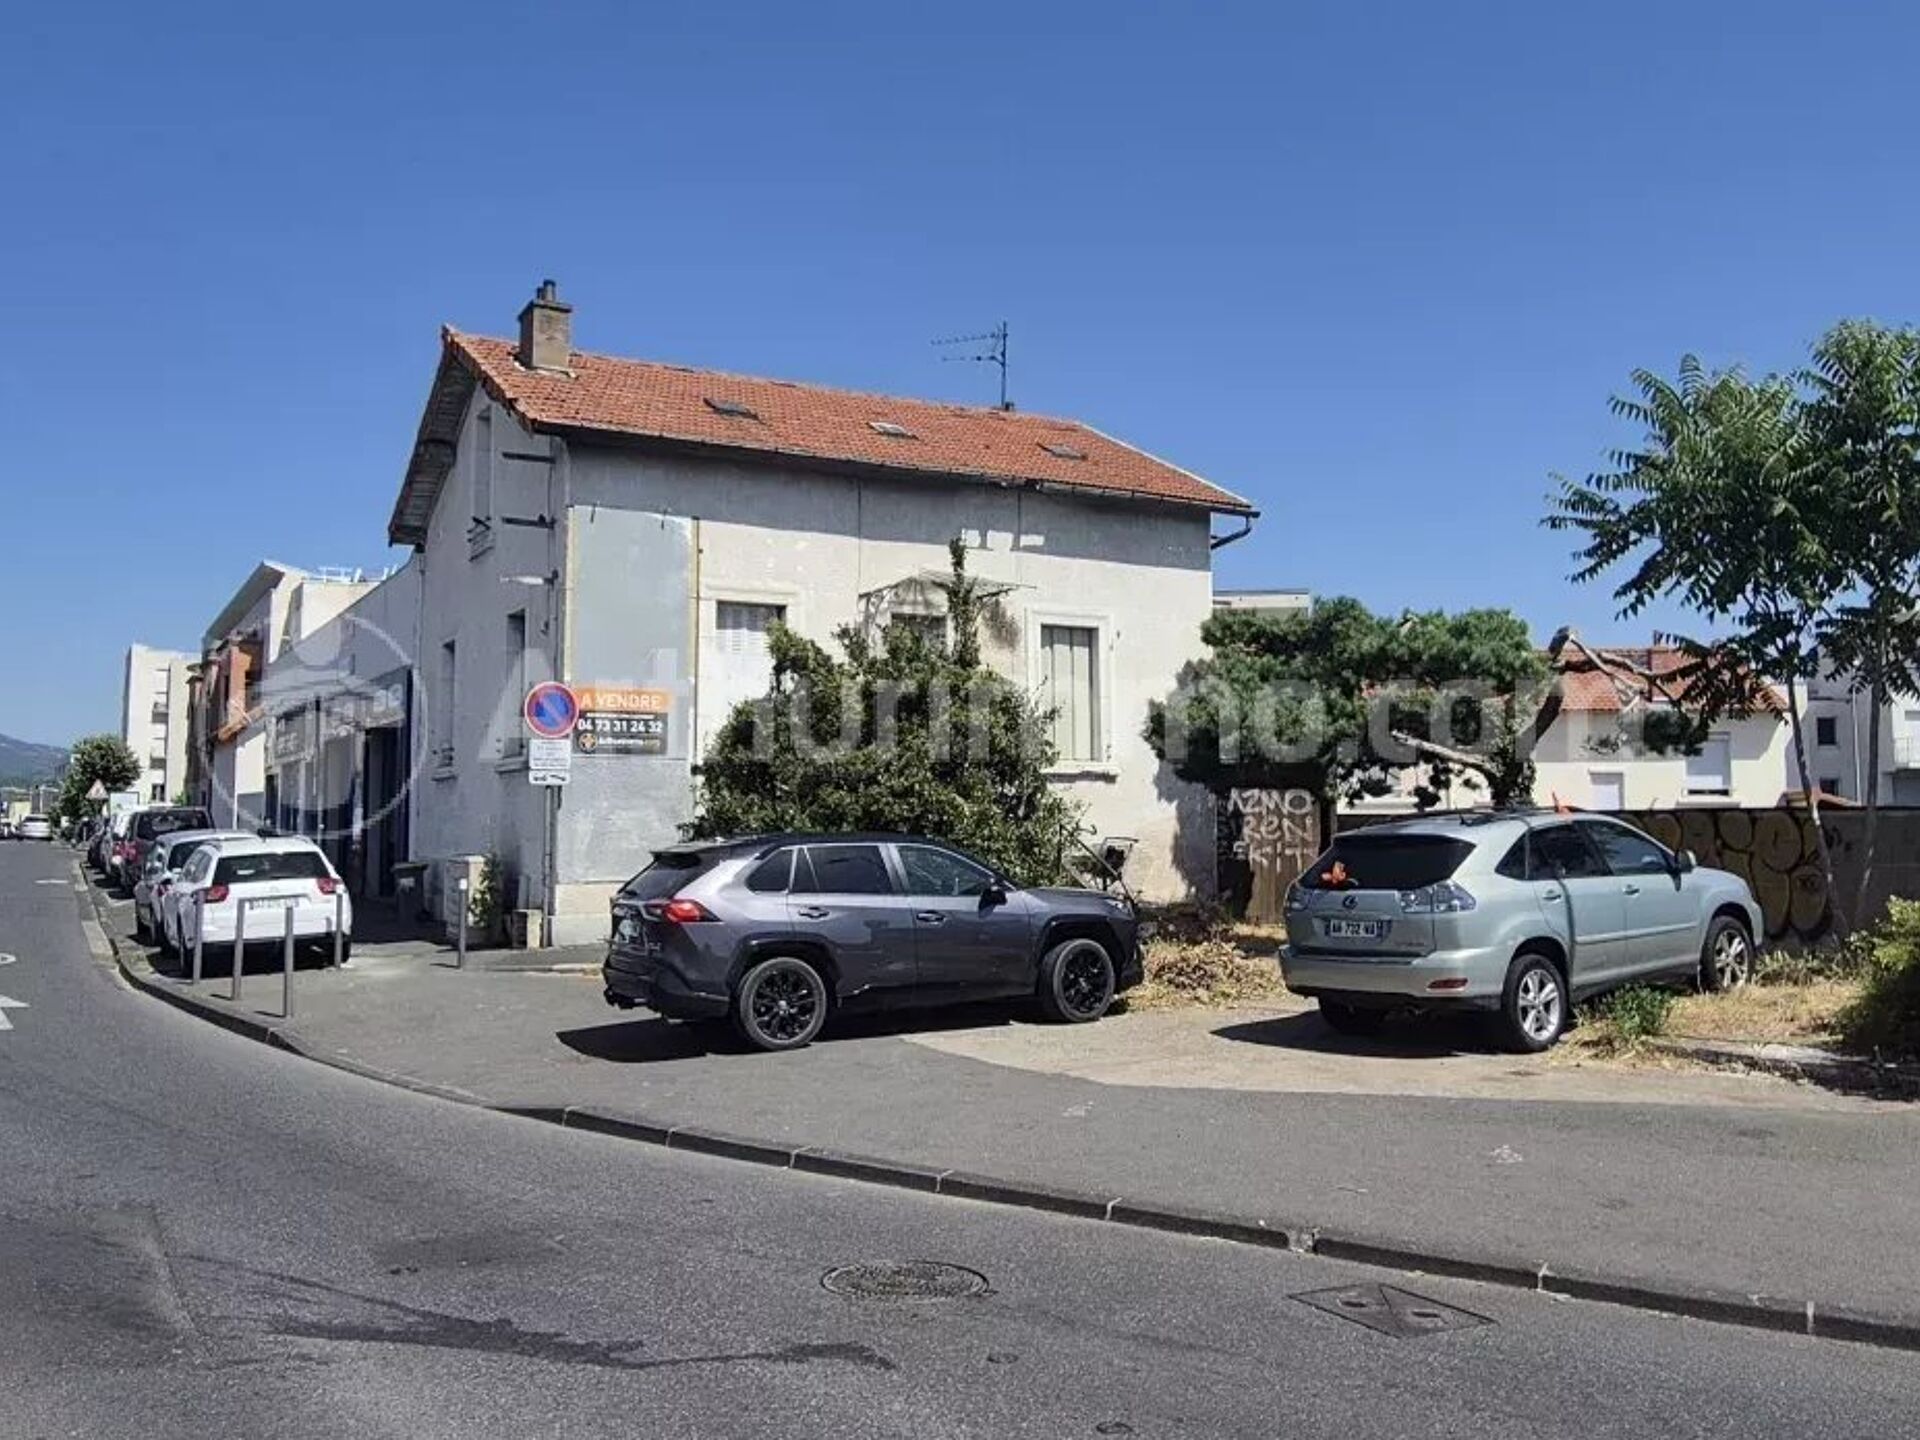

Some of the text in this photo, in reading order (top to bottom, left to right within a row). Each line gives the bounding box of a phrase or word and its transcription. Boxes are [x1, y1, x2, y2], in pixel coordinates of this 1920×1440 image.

[580, 693, 661, 709] A VENDRE
[578, 719, 663, 733] 04 73 31 24 32
